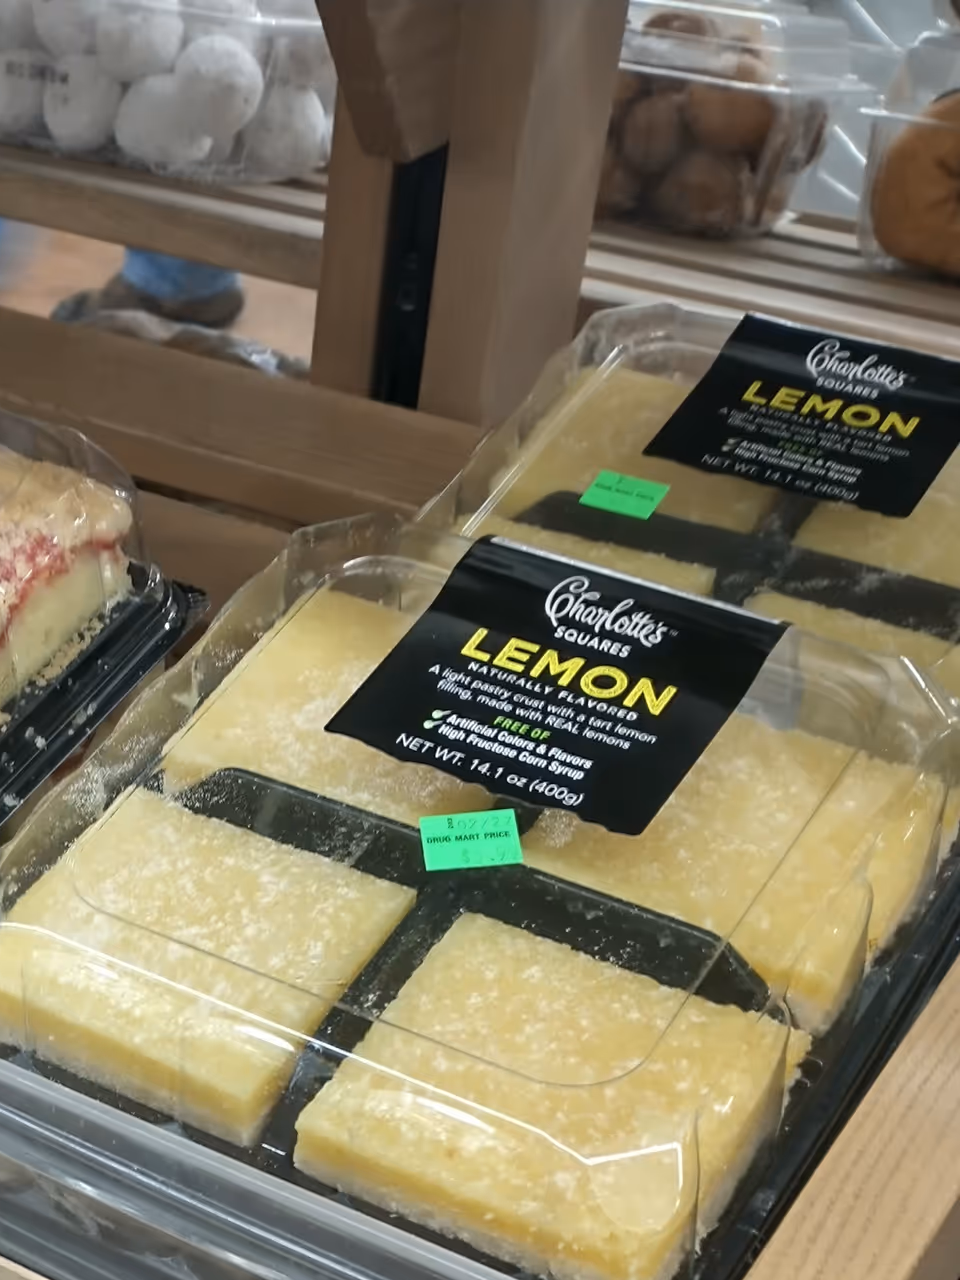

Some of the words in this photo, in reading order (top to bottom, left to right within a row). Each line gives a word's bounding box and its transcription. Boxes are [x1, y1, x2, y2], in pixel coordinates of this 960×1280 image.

[806, 338, 907, 391] Charlotte's
[816, 376, 880, 400] SQUARES
[741, 380, 921, 438] LEMON
[701, 453, 731, 468] NET
[545, 575, 669, 648] Charlotte's
[554, 625, 632, 658] SQUARES
[460, 627, 678, 716] LEMON
[468, 661, 555, 695] NATURALLY
[558, 690, 639, 722] FLAVORED
[428, 664, 441, 675] A
[442, 667, 472, 685] light
[471, 679, 512, 700] pastry
[513, 693, 545, 710] crust
[547, 703, 576, 719] with
[576, 713, 586, 723] a
[589, 714, 613, 732] tart
[614, 721, 658, 744] lemon
[437, 678, 473, 701] filling,
[477, 694, 513, 713] made
[515, 706, 544, 722] with
[545, 715, 579, 735] REAL
[582, 728, 632, 750] lemons
[493, 715, 531, 735] FREE
[530, 727, 552, 741] OF
[395, 733, 435, 753] NET
[434, 745, 465, 766] WT.
[470, 758, 505, 779] 14.1
[506, 773, 529, 788] oz
[528, 778, 585, 807] (400g)
[438, 723, 466, 741] High
[466, 733, 518, 759] Fructose
[518, 752, 549, 769] Corn
[548, 760, 585, 781] Syrup
[446, 714, 498, 738] Artificial
[497, 730, 536, 751] Colors
[536, 743, 548, 755] &
[548, 746, 594, 770] Flavors
[426, 835, 452, 844] DRUG
[454, 833, 480, 842] MART
[484, 831, 511, 840] PRICE
